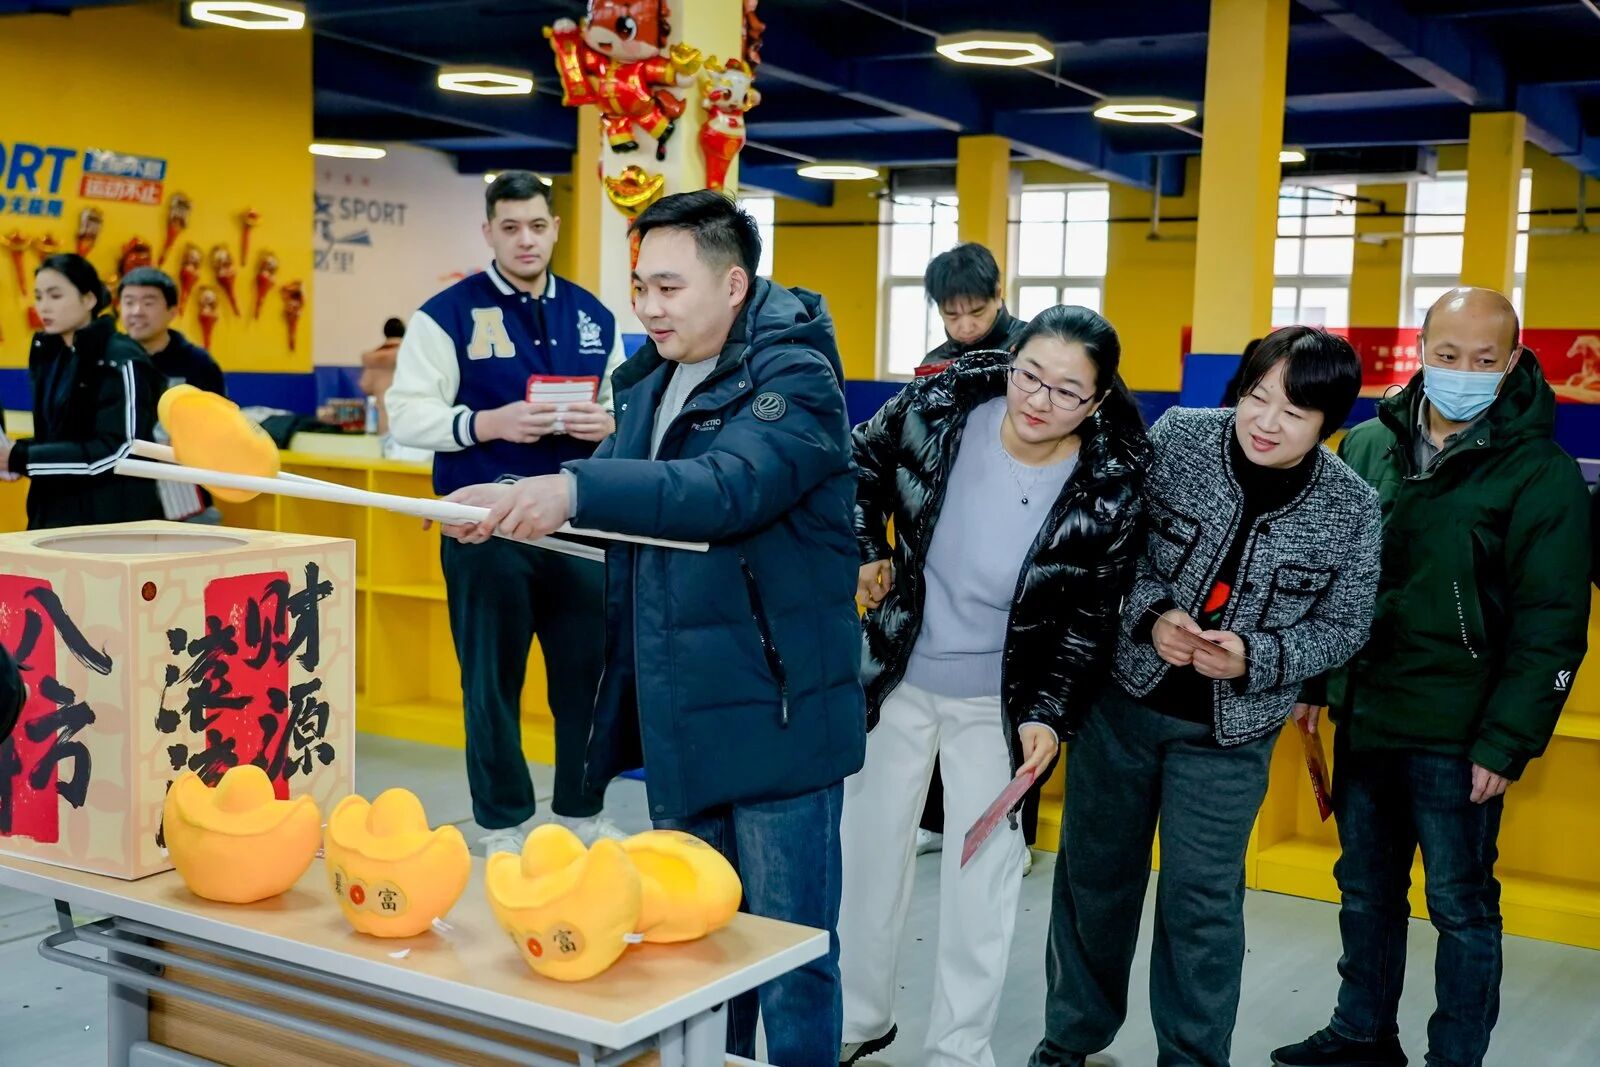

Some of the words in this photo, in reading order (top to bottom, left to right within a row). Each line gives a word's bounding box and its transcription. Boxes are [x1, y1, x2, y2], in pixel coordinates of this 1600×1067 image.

[0, 142, 77, 194] RT
[340, 197, 408, 226] SPORT
[467, 306, 516, 360] A
[242, 561, 336, 777] 财源
[16, 586, 113, 809] 八方
[378, 888, 397, 911] 富
